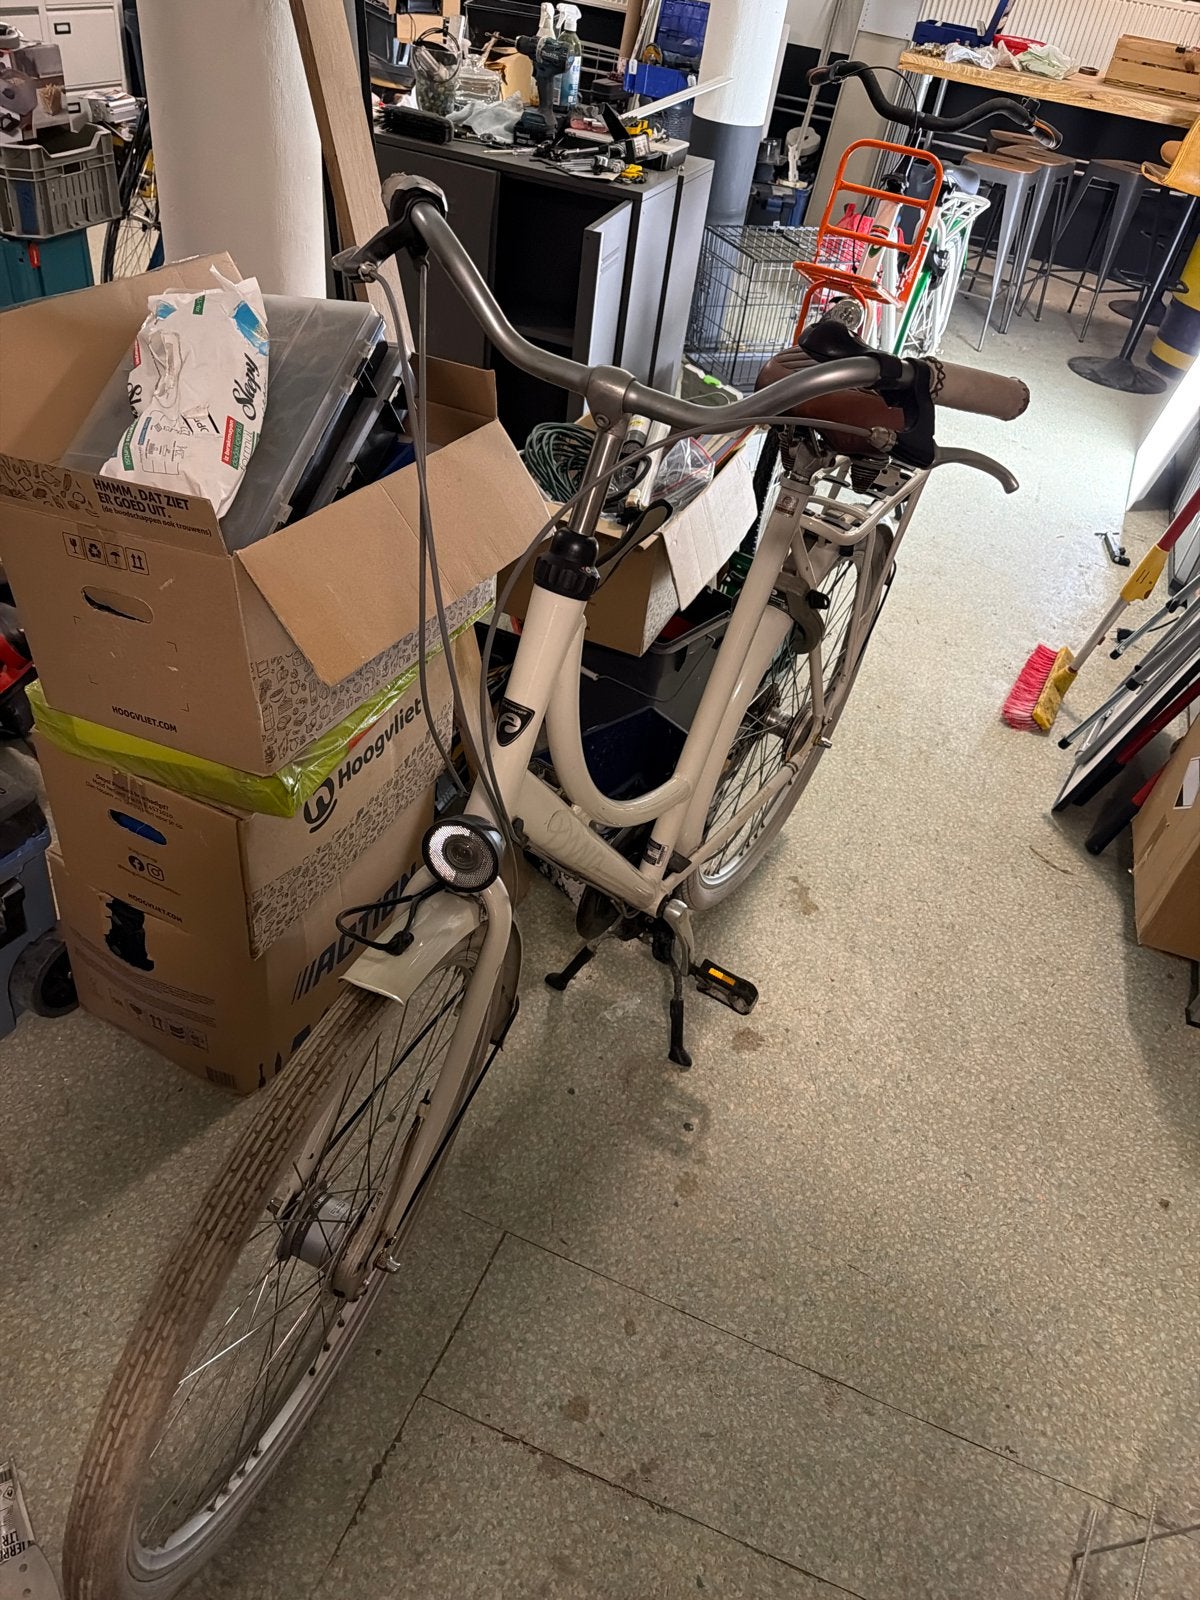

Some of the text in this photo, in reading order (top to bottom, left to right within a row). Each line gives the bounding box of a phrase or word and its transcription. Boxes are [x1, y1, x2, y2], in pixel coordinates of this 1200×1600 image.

[233, 353, 261, 420] Sleepy
[97, 491, 172, 518] ER GOED UIT.
[139, 489, 163, 505] DAT
[163, 495, 189, 511] ZIET
[111, 705, 178, 733] HOOGVLIET.COM
[338, 697, 422, 789] Hoogvliet
